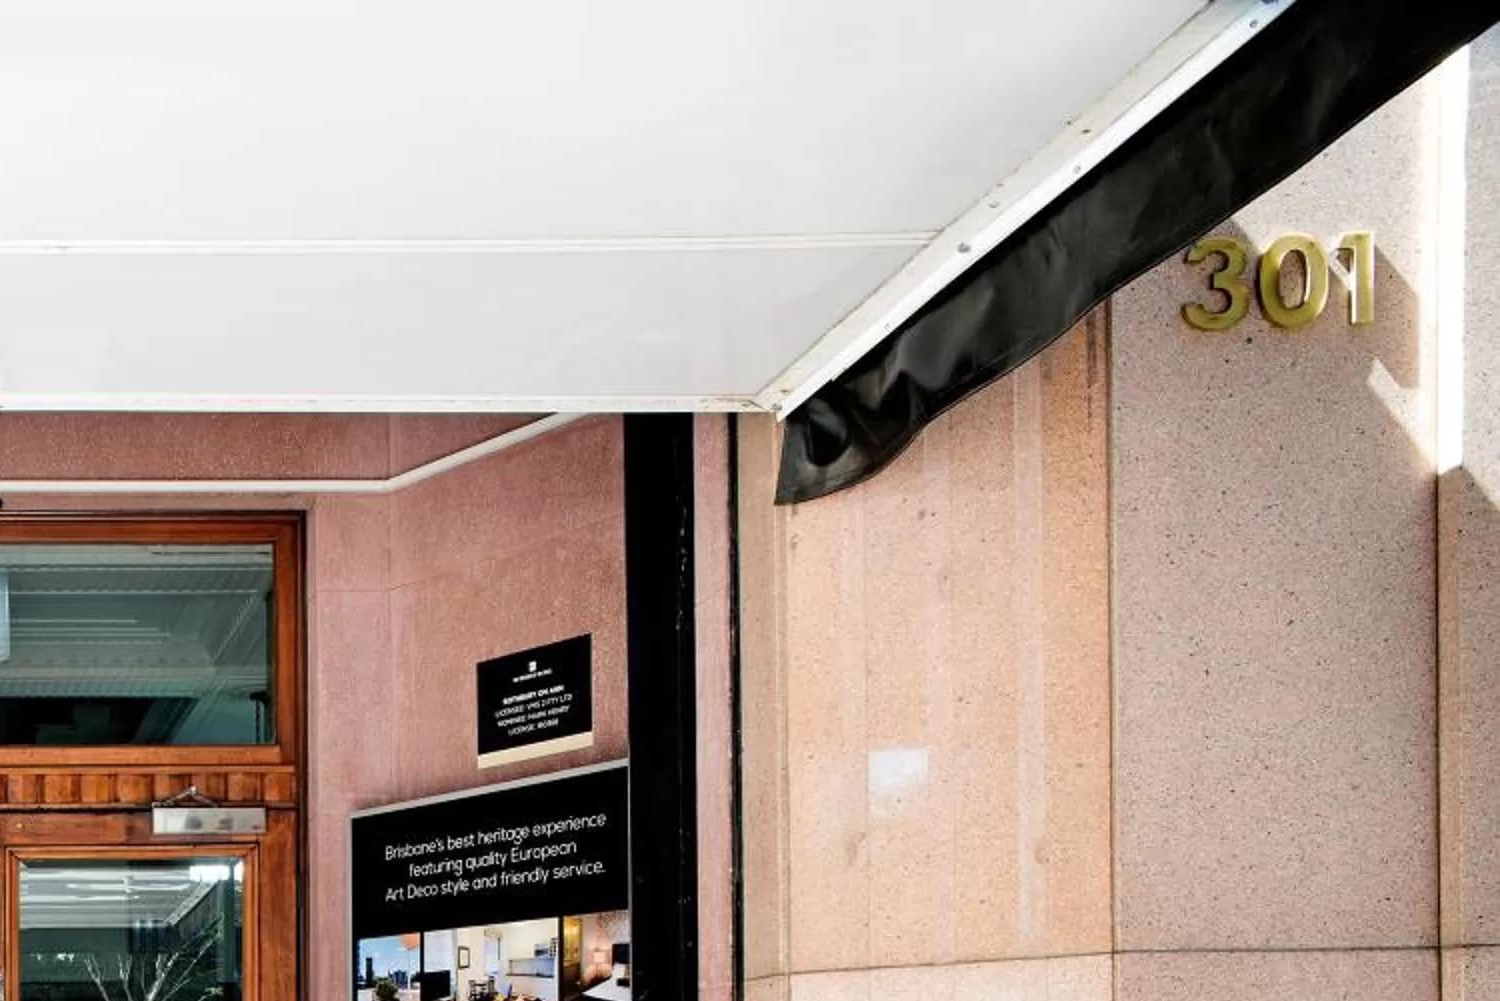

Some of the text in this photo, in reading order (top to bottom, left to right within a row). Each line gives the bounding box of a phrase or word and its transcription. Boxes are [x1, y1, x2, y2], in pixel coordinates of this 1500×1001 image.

[1180, 230, 1375, 332] 301
[385, 813, 607, 861] Brisbane's best heritage experience
[409, 840, 577, 877] featuring quality European
[385, 860, 606, 902] Art Deco style and friendly service.
